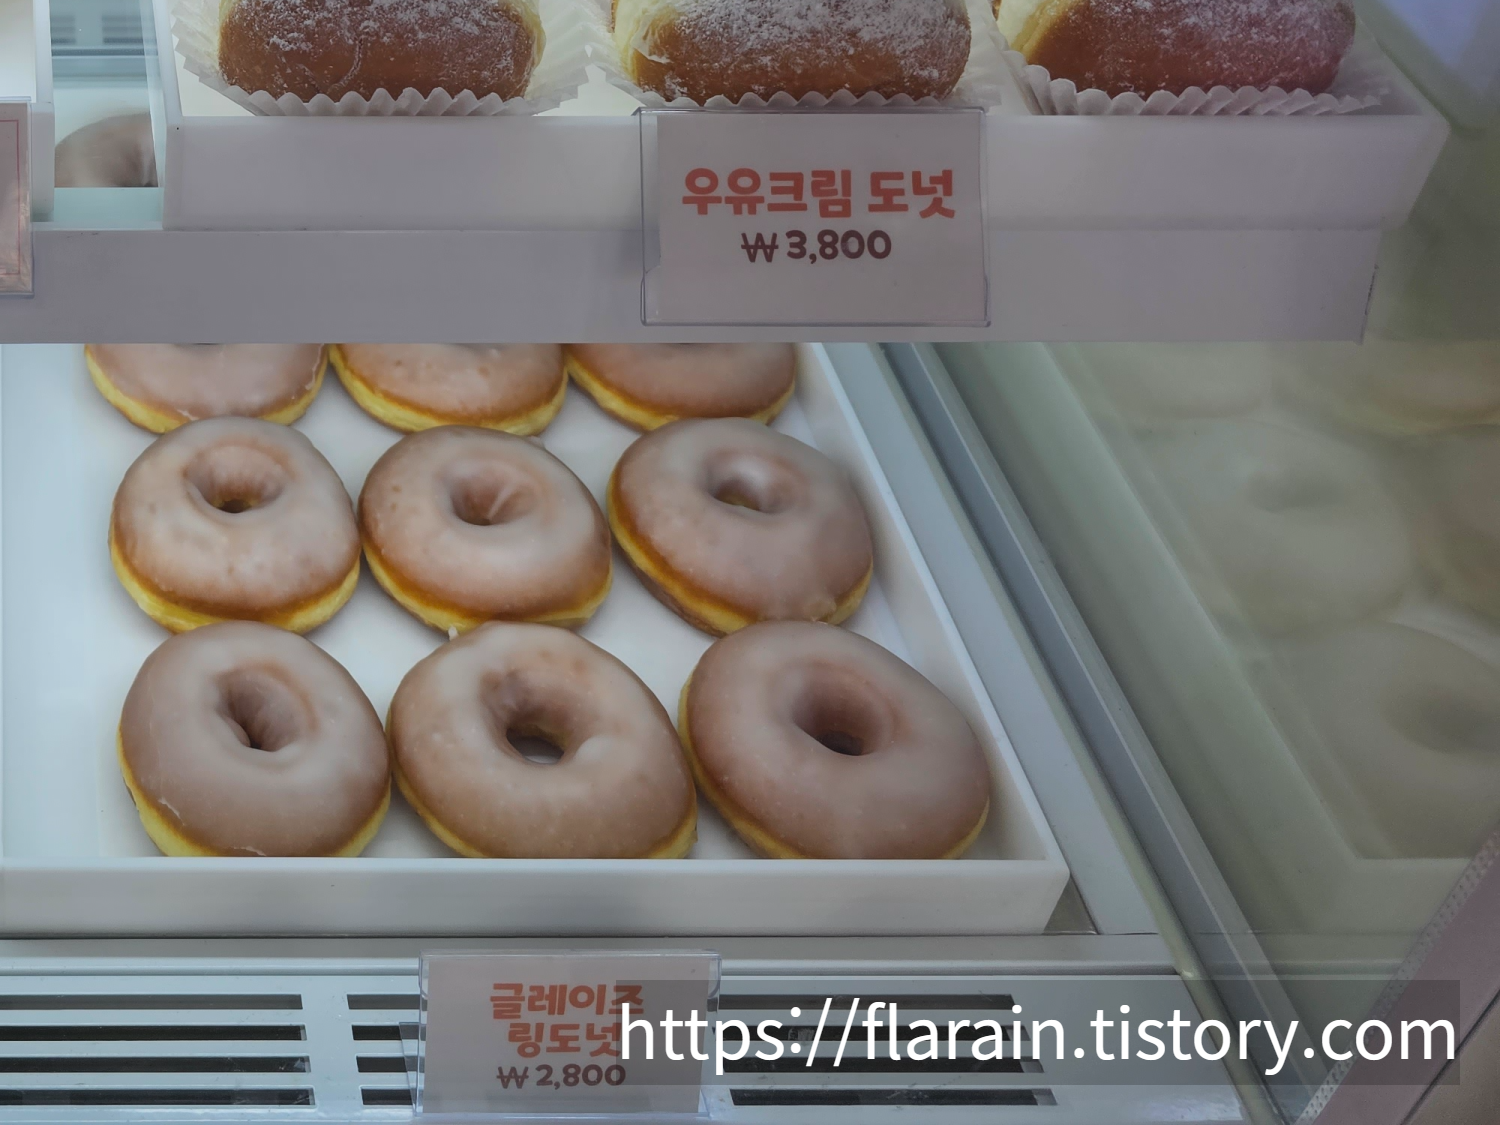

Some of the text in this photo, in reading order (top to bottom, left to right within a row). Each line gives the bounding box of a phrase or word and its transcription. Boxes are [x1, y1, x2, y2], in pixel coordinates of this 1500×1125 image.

[682, 167, 955, 219] 우유크림 도넛
[490, 982, 645, 1019] 글레이즈
[508, 1022, 624, 1058] 링도넛
